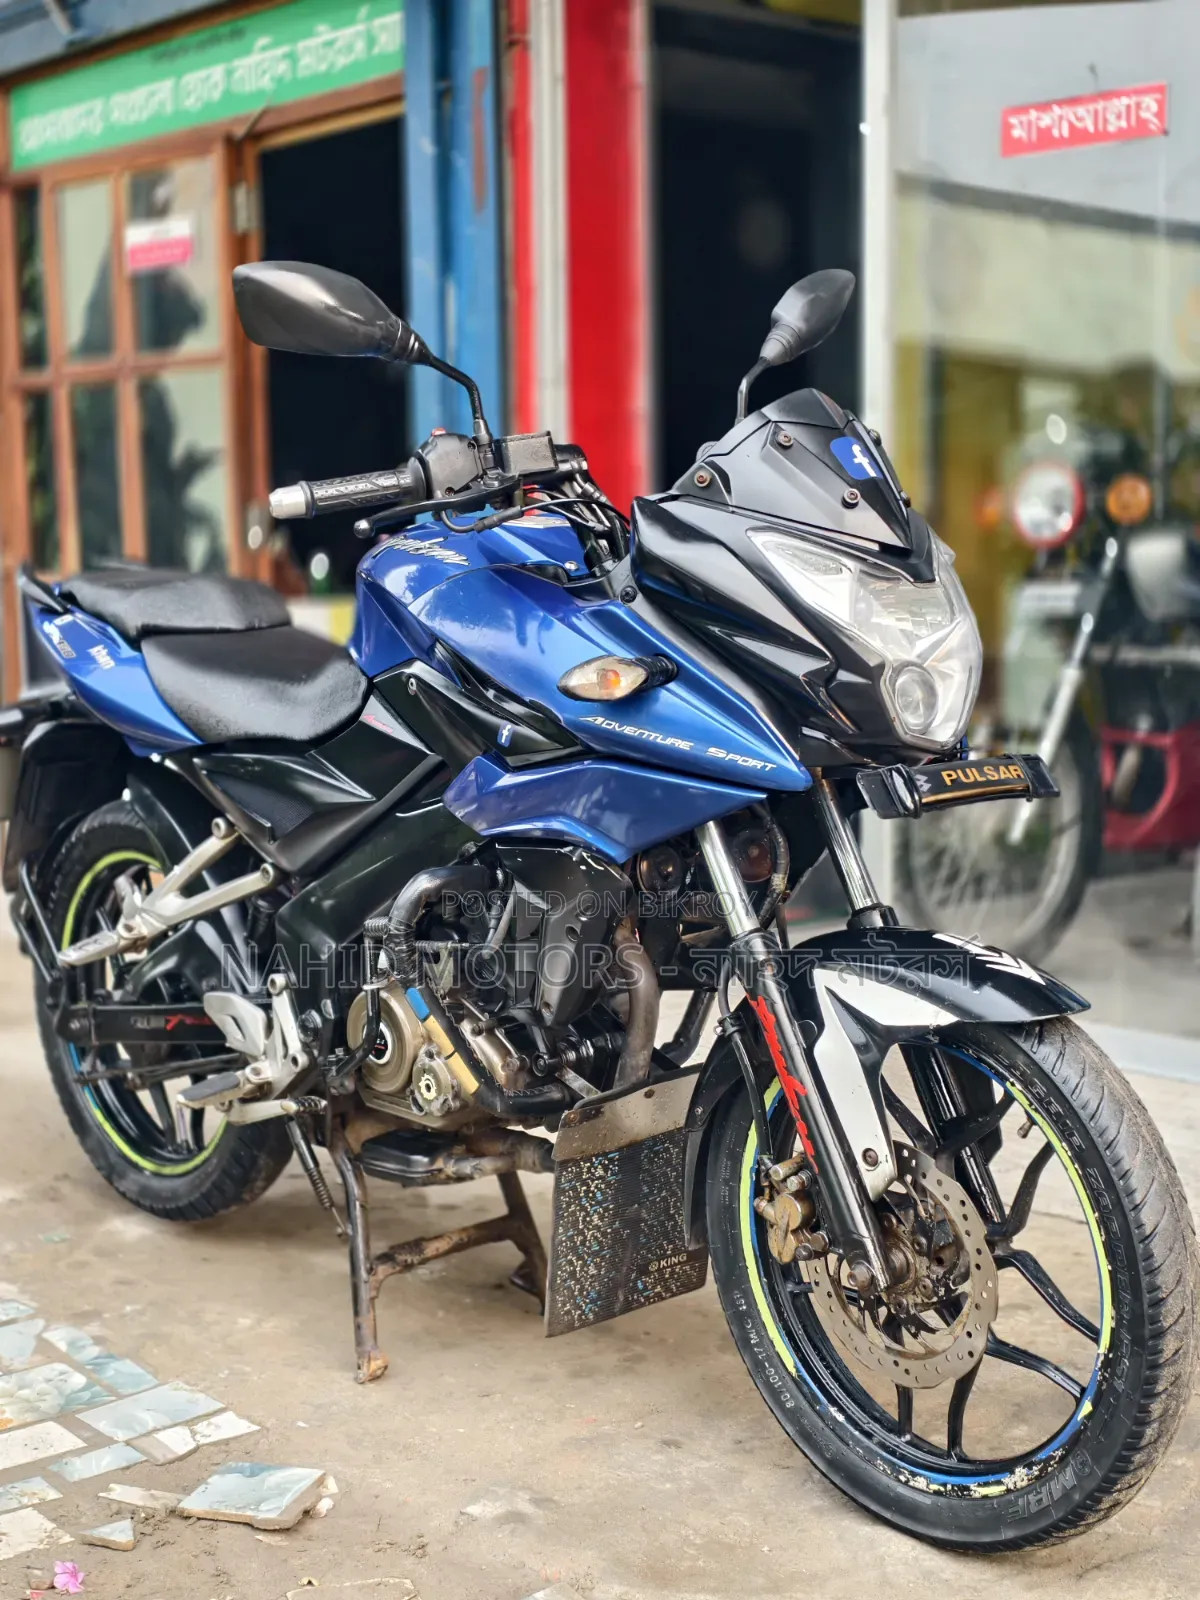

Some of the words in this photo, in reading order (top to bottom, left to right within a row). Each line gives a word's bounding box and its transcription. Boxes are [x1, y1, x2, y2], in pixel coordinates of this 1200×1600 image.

[578, 714, 694, 750] ADVENTURE
[705, 746, 777, 772] SPORT
[941, 764, 1025, 786] PULSAR
[660, 1252, 687, 1269] KING
